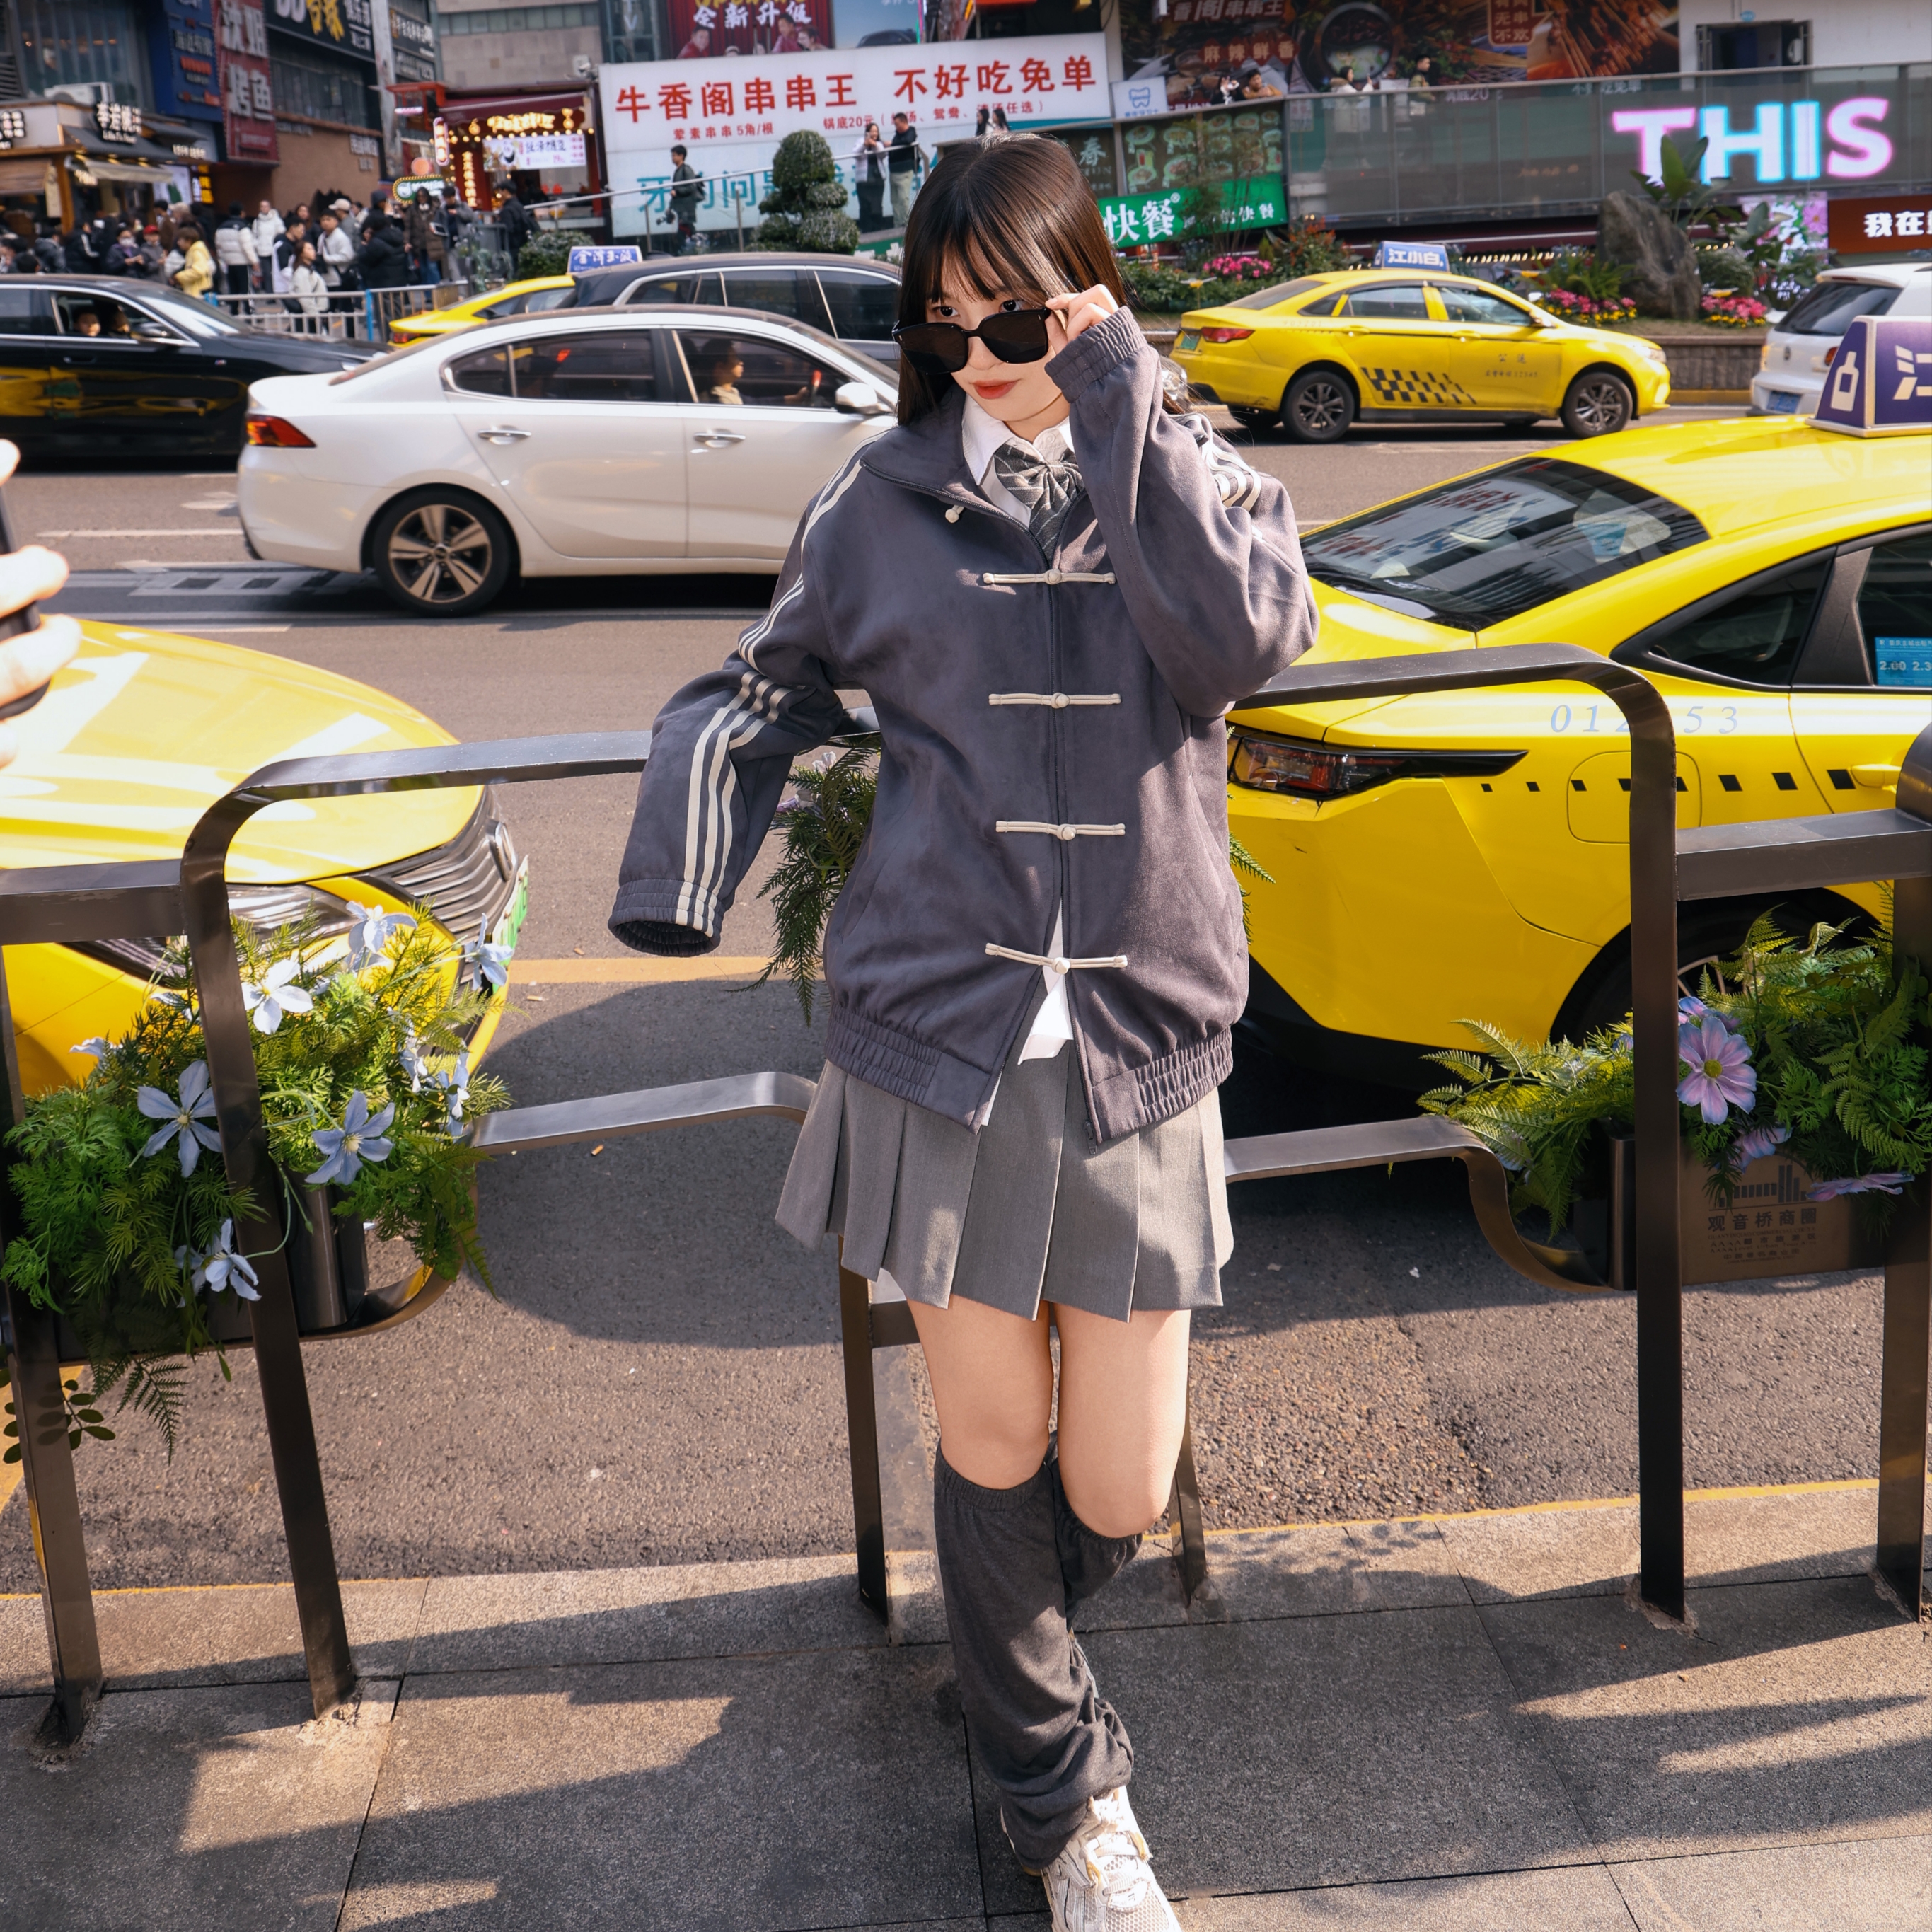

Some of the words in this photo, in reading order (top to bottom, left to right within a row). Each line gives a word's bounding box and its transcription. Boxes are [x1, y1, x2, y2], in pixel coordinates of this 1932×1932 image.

[693, 1, 812, 29] 全新升级
[1155, 0, 1283, 21] 香阁串串王
[1204, 40, 1295, 64] 麻辣鲜香
[226, 63, 274, 121] 烤鱼
[615, 74, 857, 122] 牛香阁串串王
[893, 54, 1097, 103] 不好吃免单
[1080, 136, 1107, 167] 春
[1612, 98, 1894, 186] THIS
[1104, 198, 1176, 245] 快餐
[1864, 211, 1932, 238] 我在
[1551, 705, 1738, 734] 0153
[1708, 1208, 1817, 1232] 观音桥商圈
